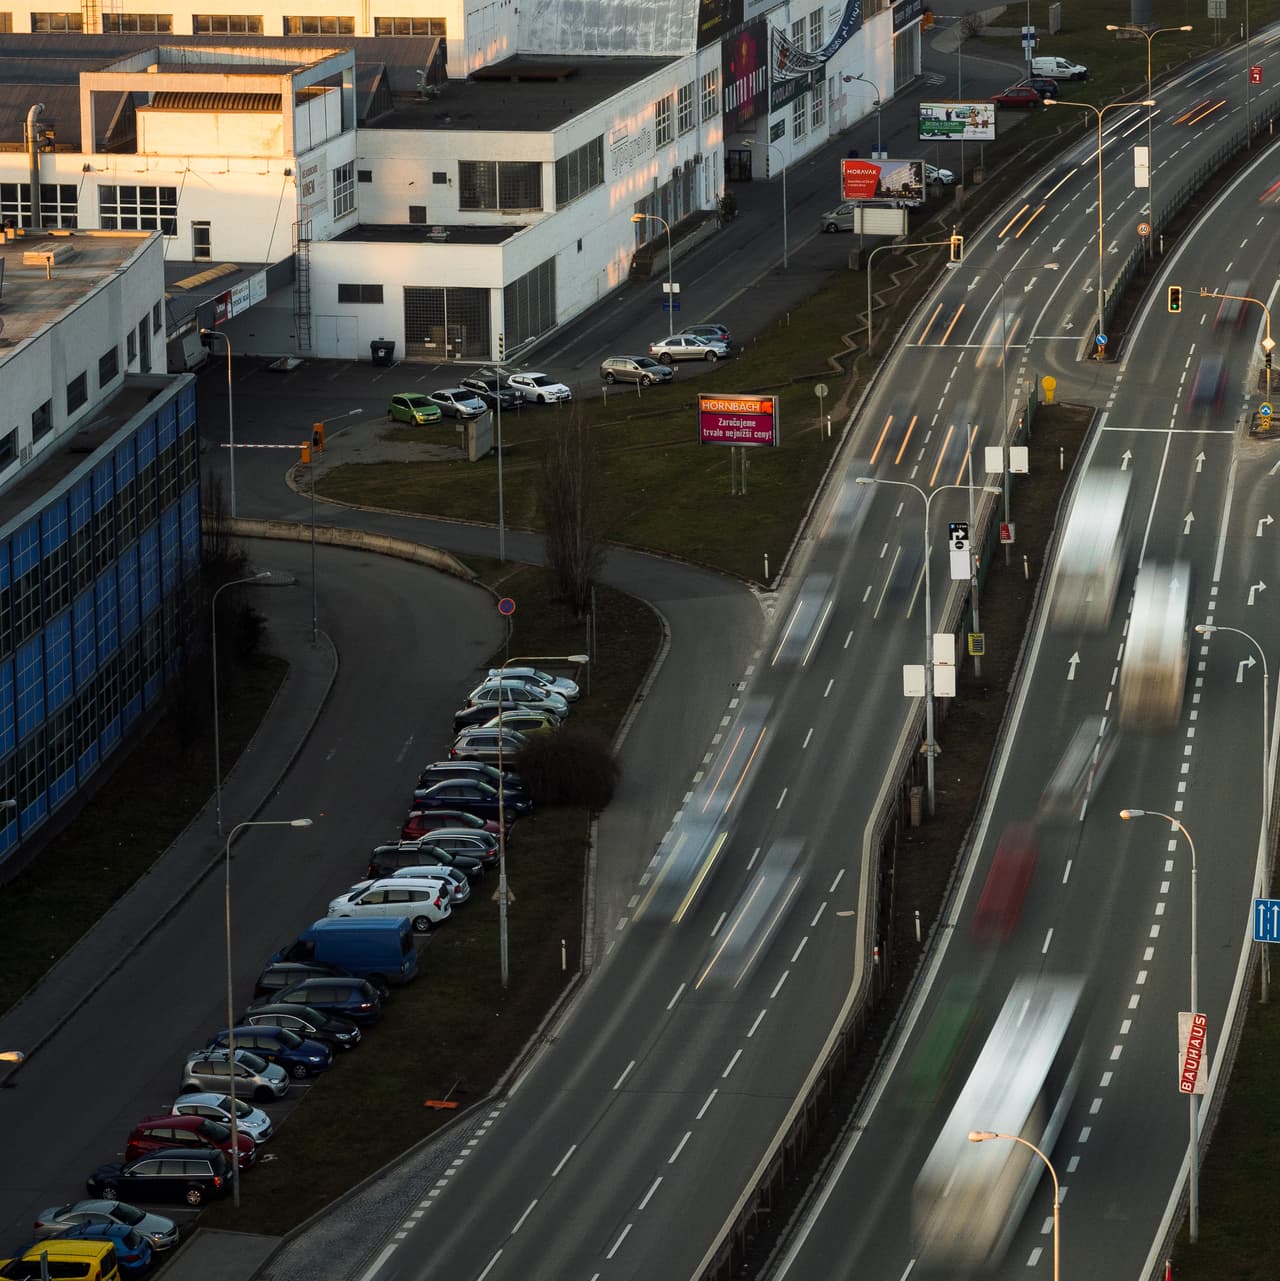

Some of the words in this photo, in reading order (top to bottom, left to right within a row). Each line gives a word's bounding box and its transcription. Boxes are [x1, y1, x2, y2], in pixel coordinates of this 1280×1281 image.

[702, 401, 760, 411] HORNBACH
[718, 418, 756, 428] Zaručujeme
[703, 429, 723, 437] trvale
[725, 428, 752, 439] nejnižší
[754, 430, 772, 440] ceny!
[1181, 1016, 1206, 1091] BAUHAUS
